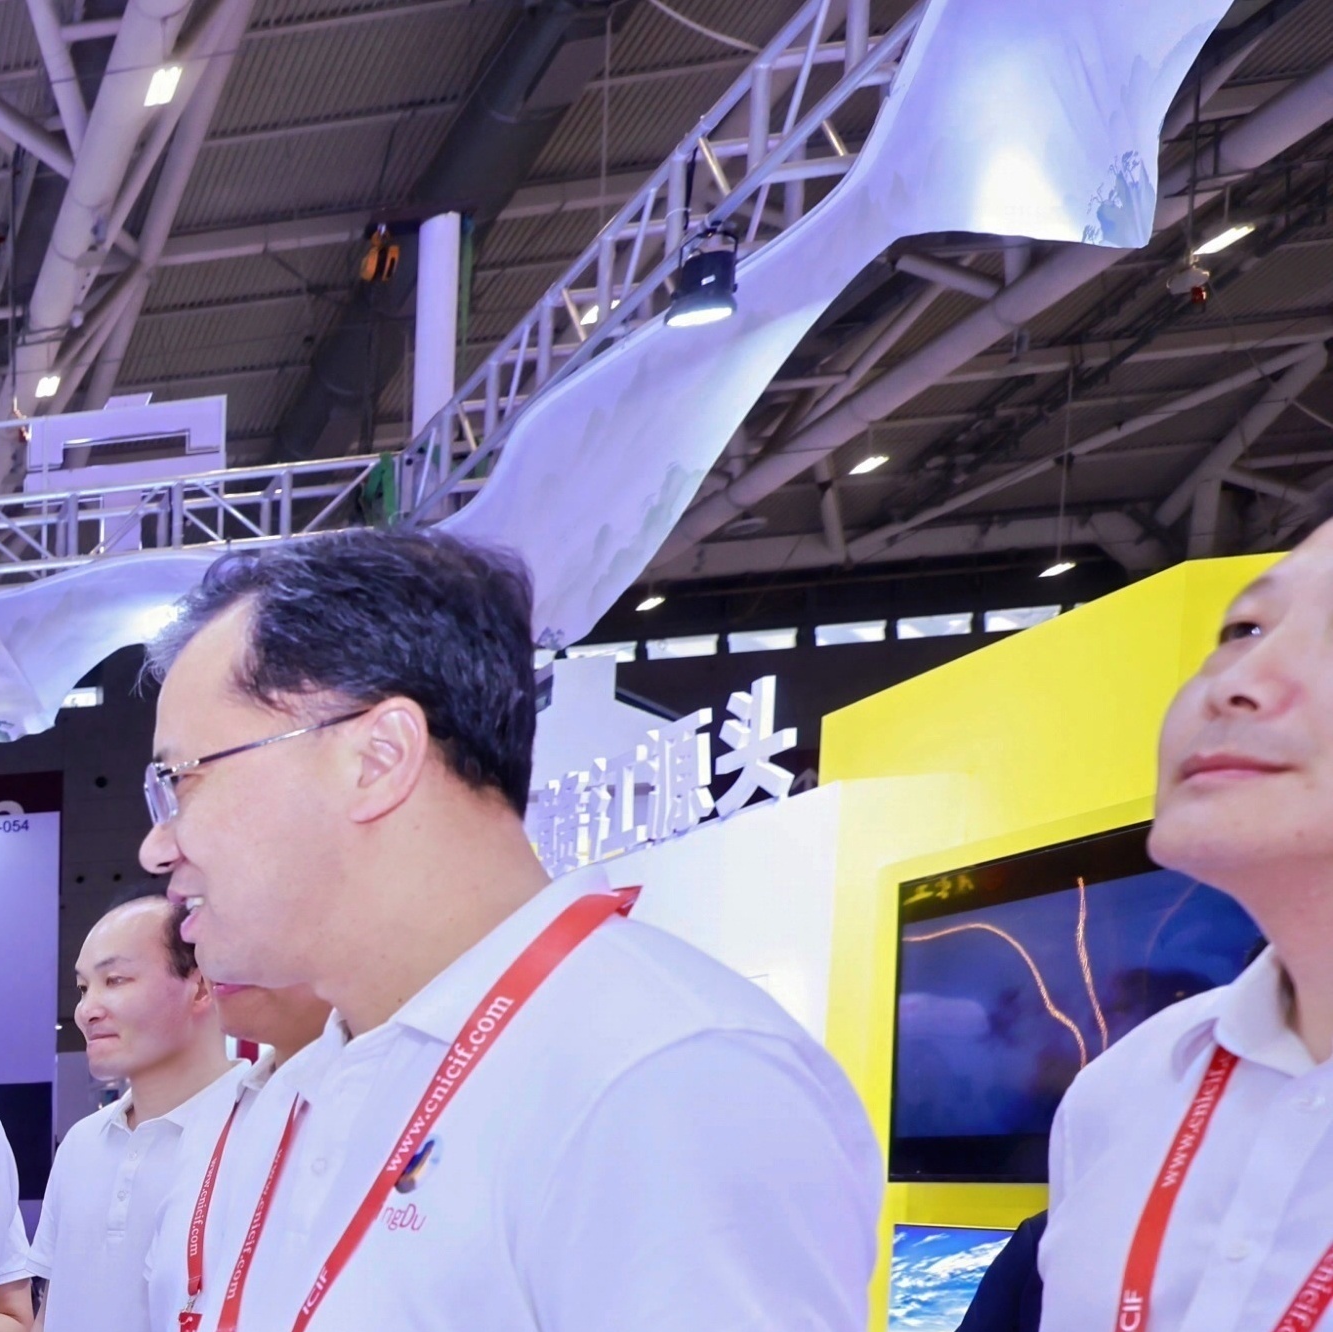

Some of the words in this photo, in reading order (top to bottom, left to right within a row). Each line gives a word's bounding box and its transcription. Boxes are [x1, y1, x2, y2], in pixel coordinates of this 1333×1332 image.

[386, 995, 514, 1173] www.cnicif.com
[1161, 1056, 1233, 1188] www.cnicif.
[189, 1157, 217, 1257] www.cnicif.com
[226, 1149, 283, 1300] www.cnicif.com
[381, 1203, 427, 1232] ngDu
[302, 1265, 330, 1315] ICIF
